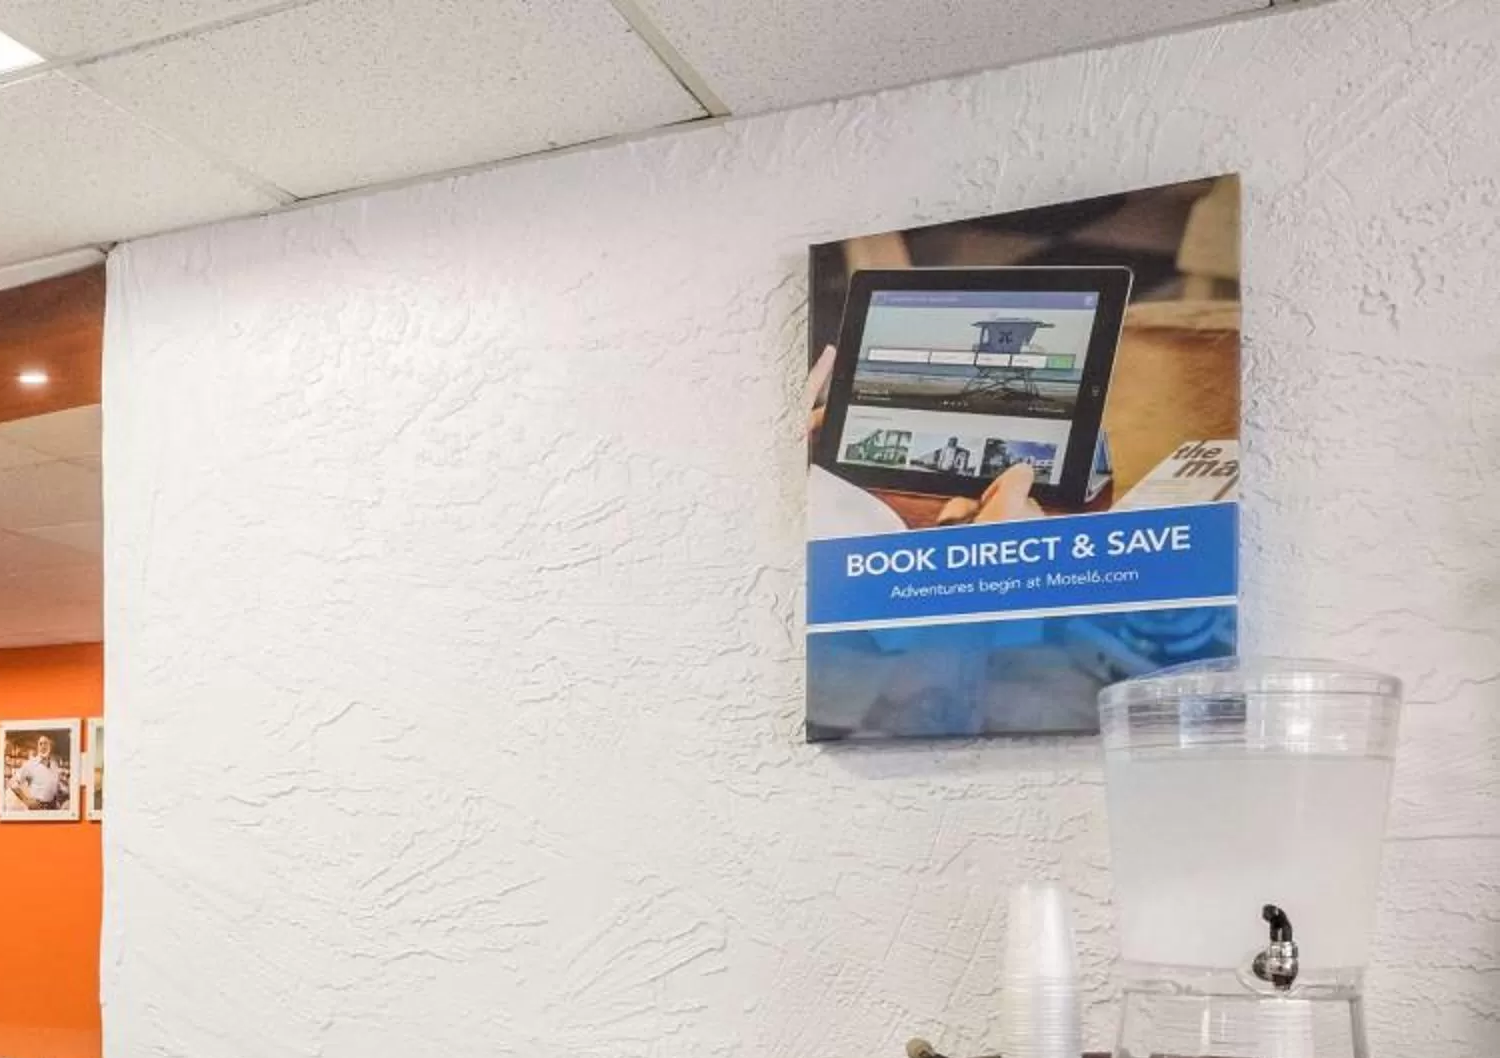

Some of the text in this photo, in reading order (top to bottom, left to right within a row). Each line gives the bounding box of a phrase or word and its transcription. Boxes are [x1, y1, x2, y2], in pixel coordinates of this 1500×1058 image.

[846, 524, 1192, 578] BOOK DIRECT & SAVE
[890, 568, 1140, 600] Adventures begin at Motel6.com
